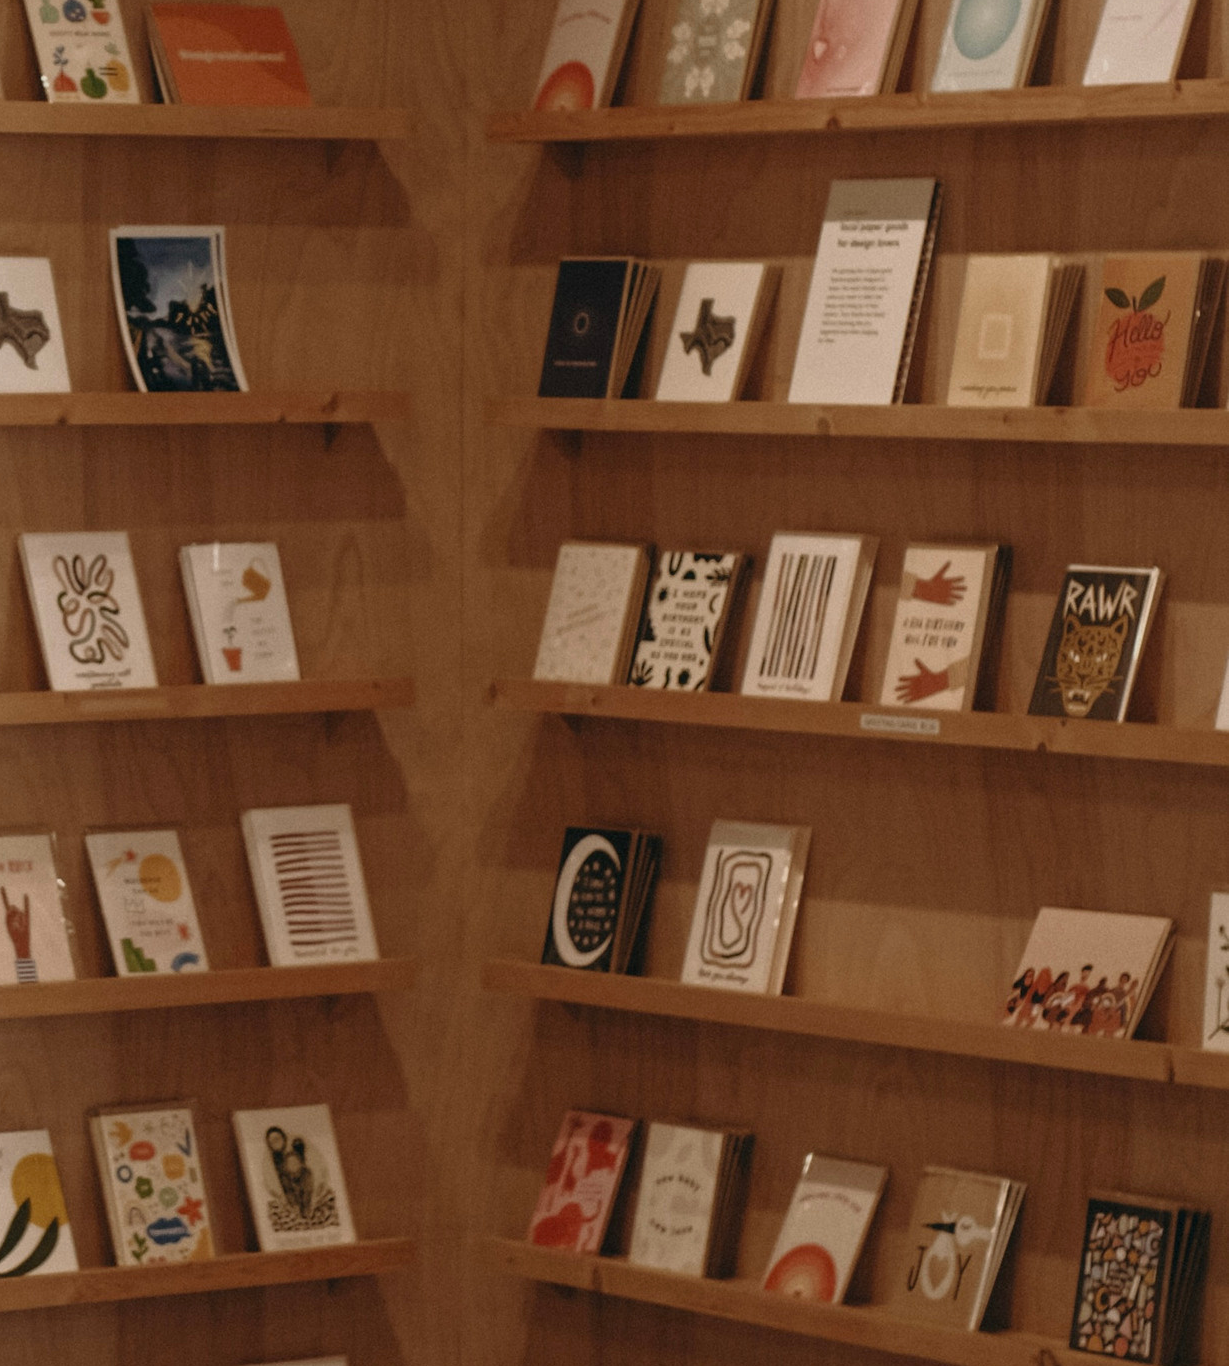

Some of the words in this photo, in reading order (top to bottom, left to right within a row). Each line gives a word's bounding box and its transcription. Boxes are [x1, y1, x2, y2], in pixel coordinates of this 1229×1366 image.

[850, 239, 875, 251] design
[1107, 309, 1171, 363] Hello
[1113, 362, 1162, 392] you
[1063, 578, 1139, 623] RAWR
[907, 1240, 972, 1301] JOY
